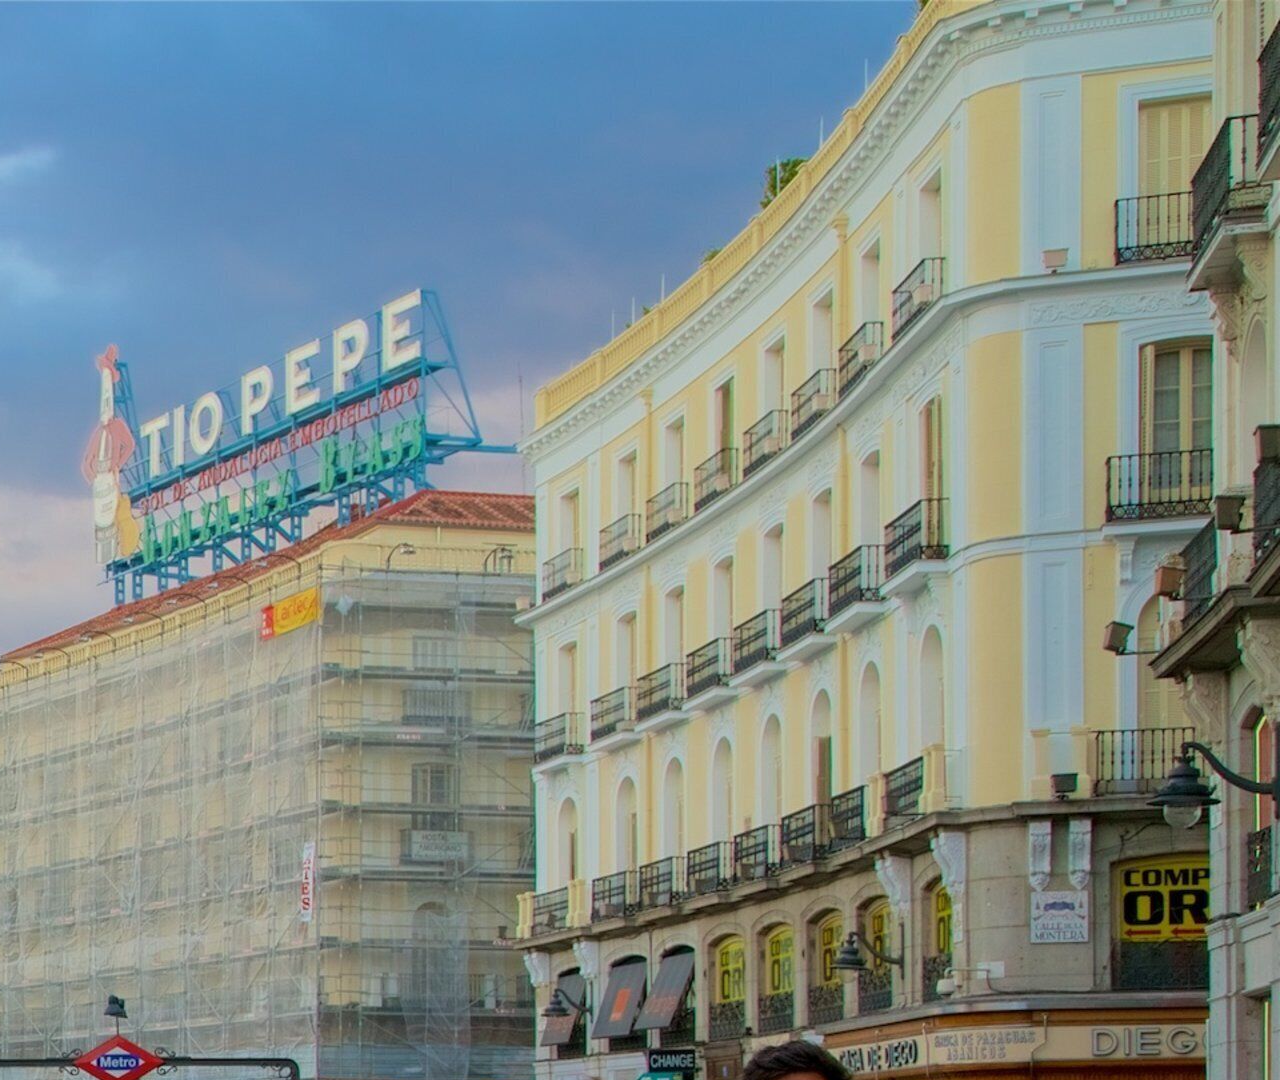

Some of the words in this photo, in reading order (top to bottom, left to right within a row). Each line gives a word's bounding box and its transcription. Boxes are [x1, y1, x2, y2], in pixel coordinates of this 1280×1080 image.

[140, 390, 223, 479] TIO
[241, 288, 422, 436] PEPE
[140, 490, 169, 516] SOL
[172, 477, 194, 501] DE
[1034, 922, 1061, 930] CALLE
[1034, 930, 1086, 941] MONTERA
[1091, 1026, 1206, 1057] DIEG
[99, 1055, 137, 1069] Metro
[650, 1053, 694, 1069] CHANGE
[867, 1045, 882, 1071] DE
[884, 1038, 918, 1068] DIEGO
